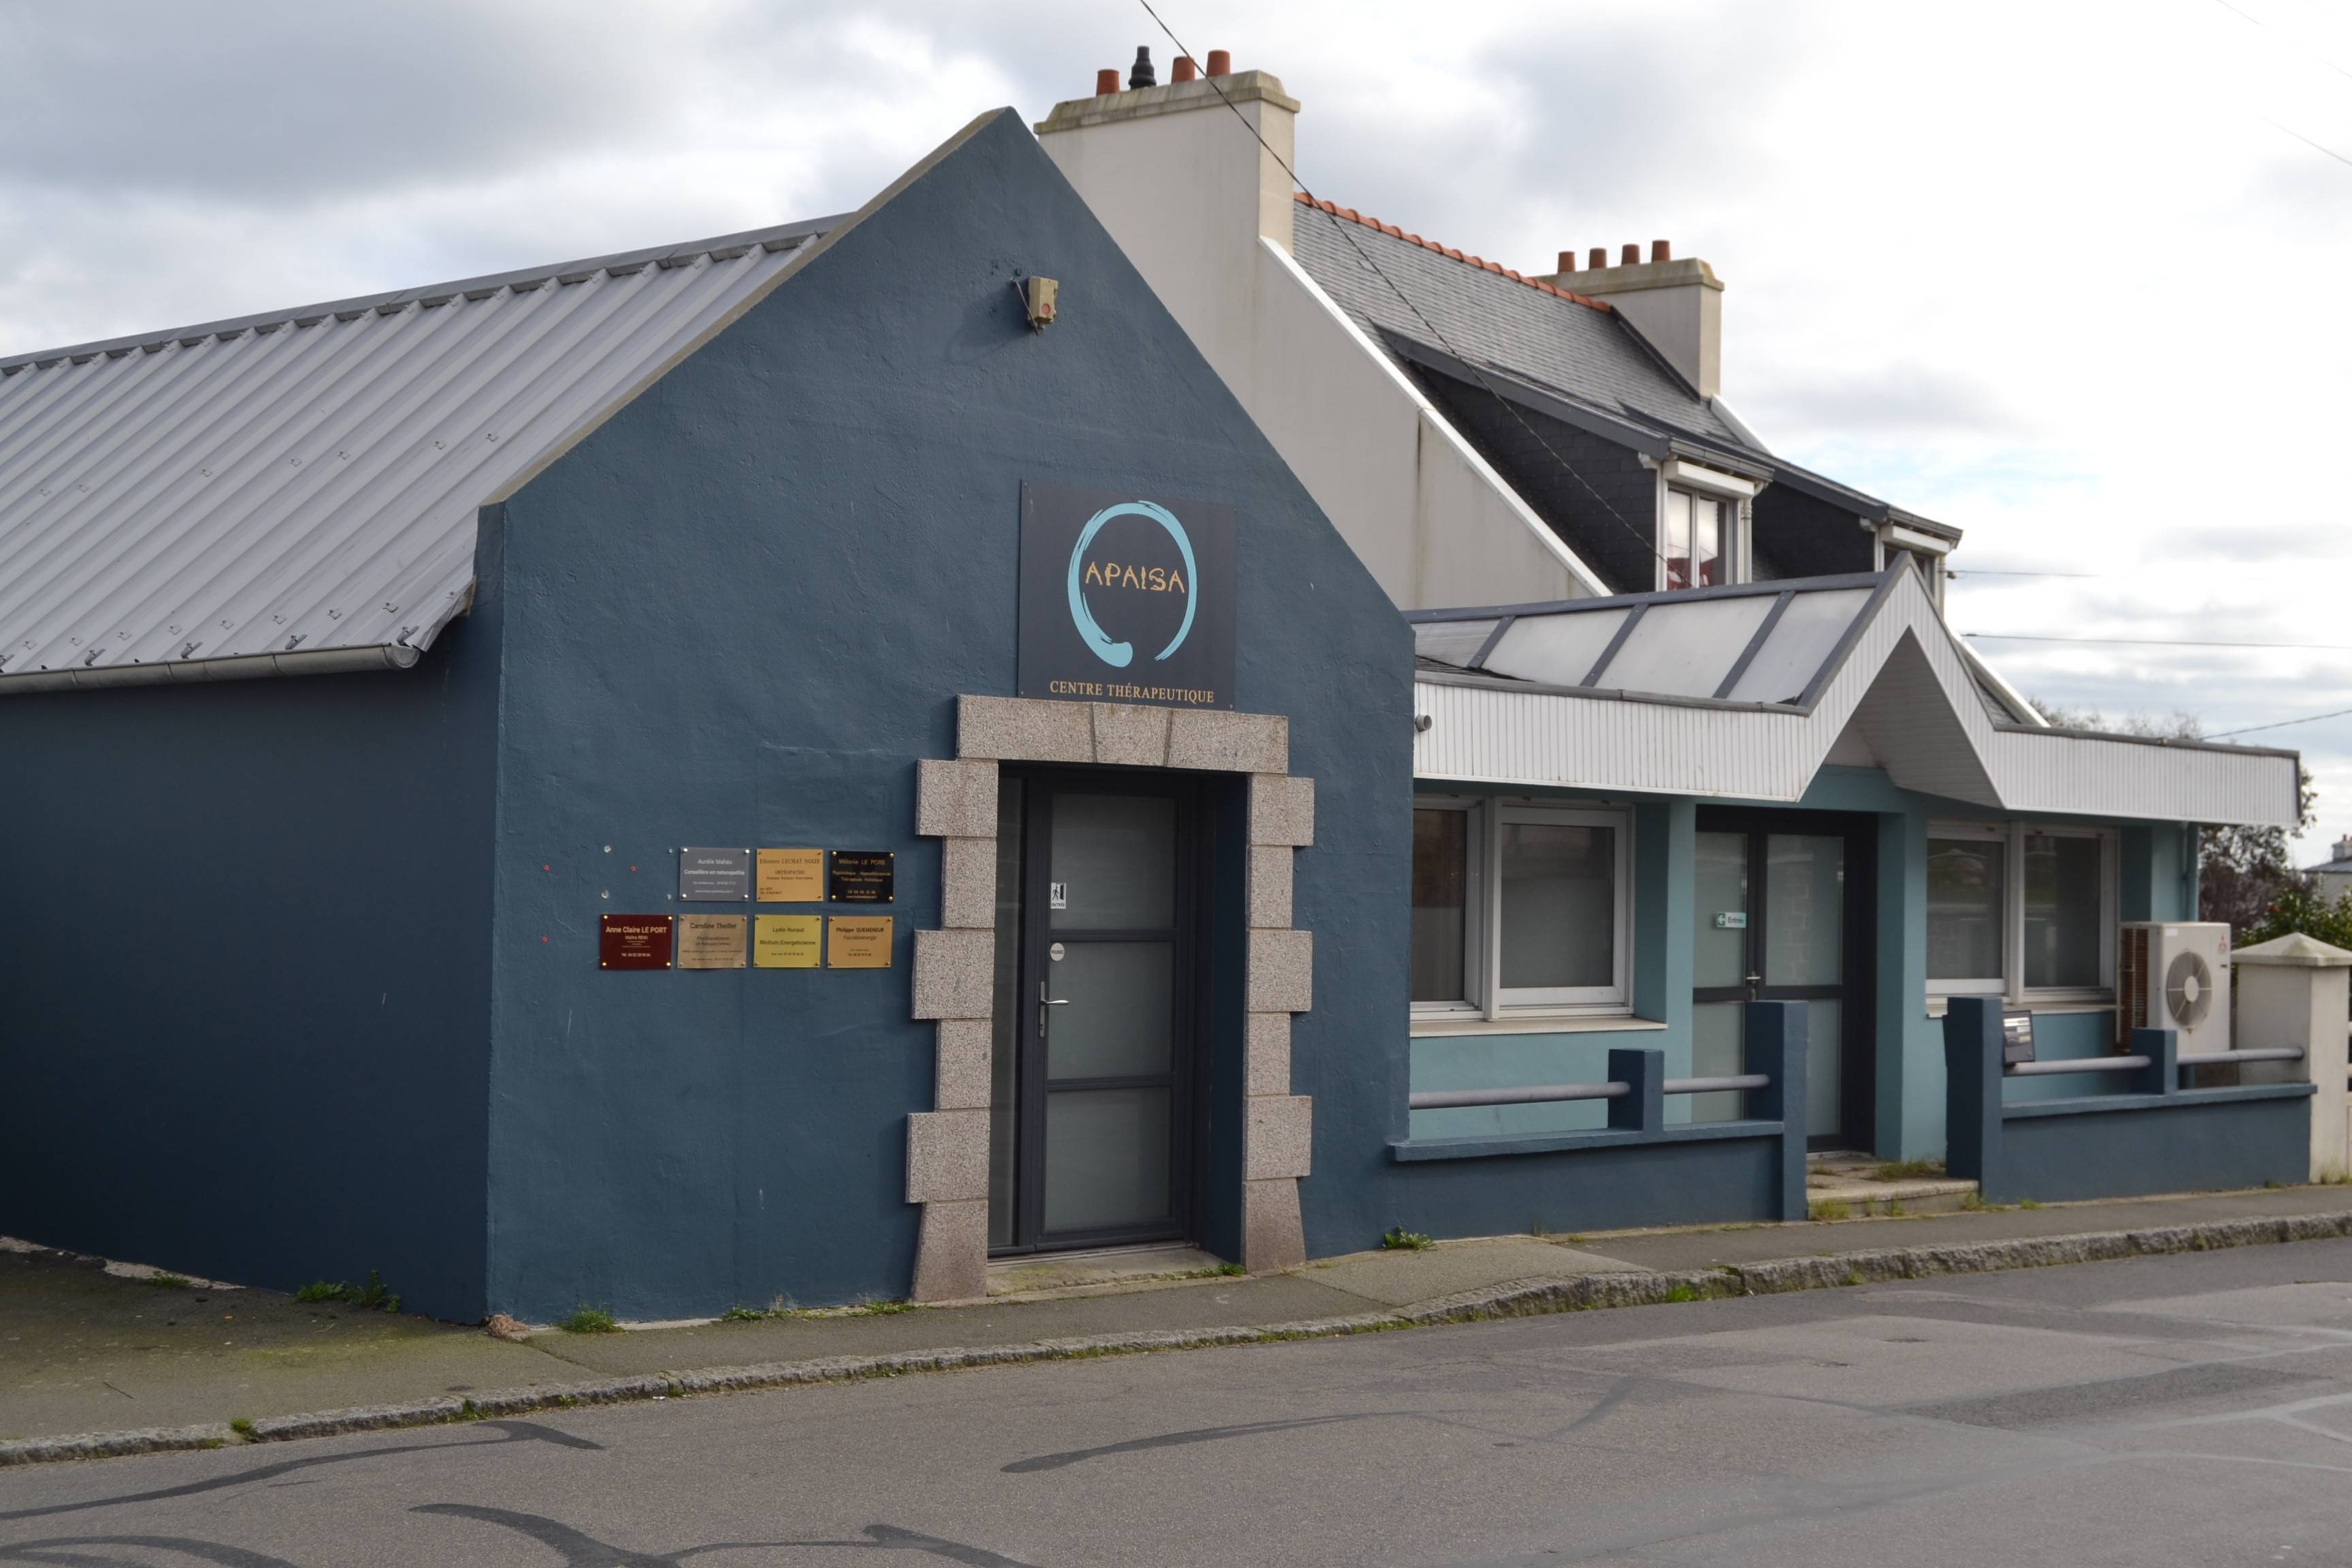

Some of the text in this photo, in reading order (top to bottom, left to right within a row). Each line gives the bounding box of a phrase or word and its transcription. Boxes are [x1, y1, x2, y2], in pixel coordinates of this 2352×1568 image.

[1085, 561, 1186, 593] APAISA
[1049, 681, 1214, 704] CENTRE THÉRAPEUTIQUE
